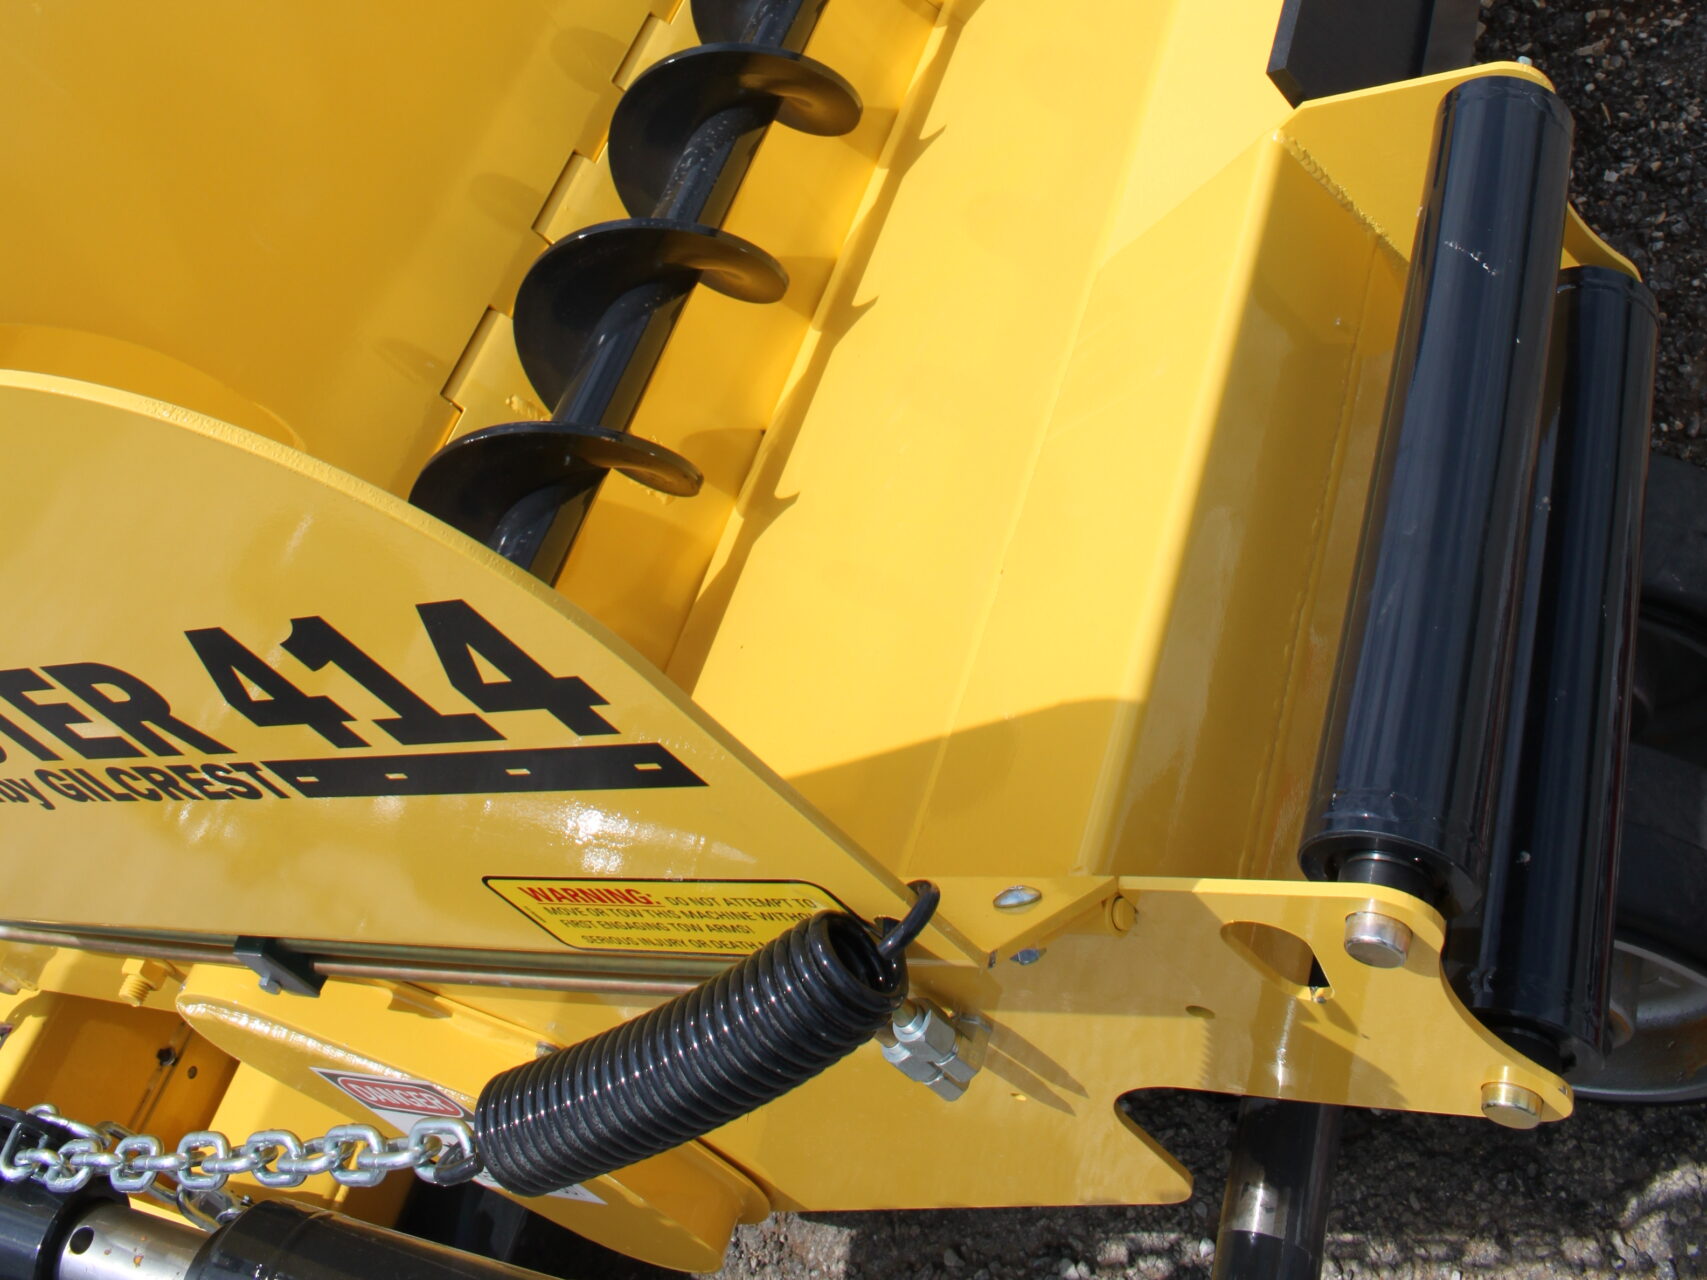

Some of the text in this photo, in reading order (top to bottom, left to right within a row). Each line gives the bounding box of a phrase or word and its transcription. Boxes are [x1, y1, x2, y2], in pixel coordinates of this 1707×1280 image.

[184, 599, 621, 749] 414
[34, 761, 291, 802] GILCREST
[517, 887, 817, 909] WARNING: DO NOT ATTEMPT TO
[542, 906, 587, 916] MOVE
[586, 907, 607, 917] OR
[607, 908, 644, 918] TOW
[642, 909, 681, 919] THIS
[684, 910, 758, 921] MACHINE
[560, 919, 594, 928] FIRST
[596, 920, 669, 931] ENGAGING
[669, 922, 705, 932] TOW
[580, 935, 635, 946] SERIOUS
[637, 936, 688, 947] INJURY
[687, 938, 709, 948] OR
[710, 940, 759, 950] DEATH
[348, 1083, 452, 1112] DANGER
